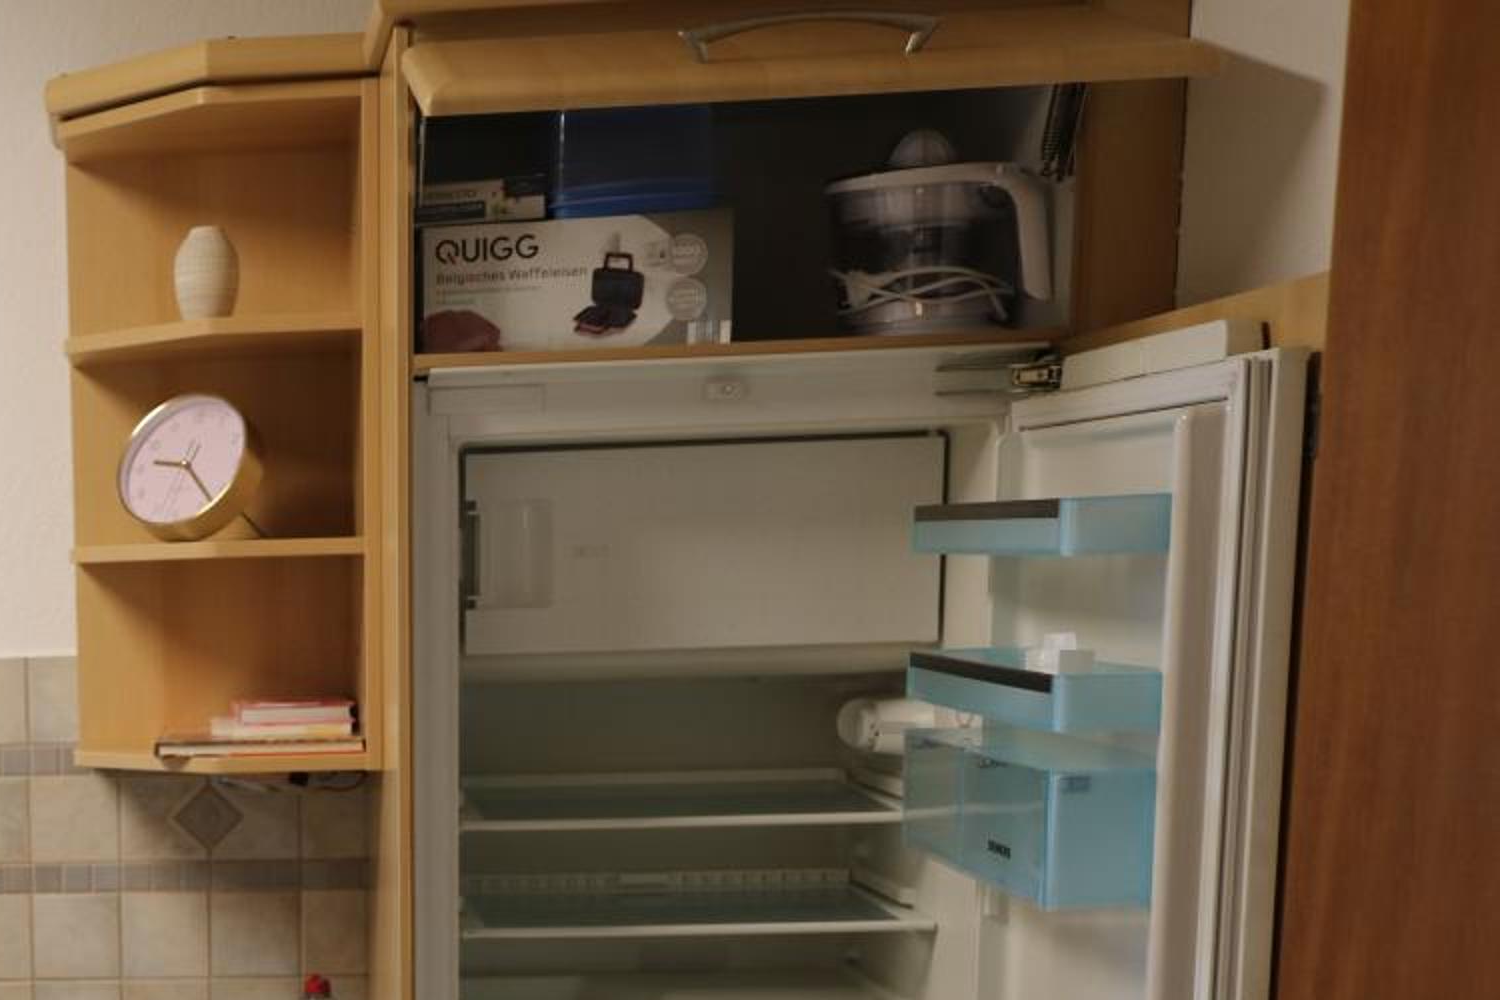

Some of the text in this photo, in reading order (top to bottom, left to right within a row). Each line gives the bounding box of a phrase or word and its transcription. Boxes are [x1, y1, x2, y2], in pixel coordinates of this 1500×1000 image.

[435, 234, 539, 265] QUIGG
[436, 267, 587, 285] Belgisches Waffeleisen
